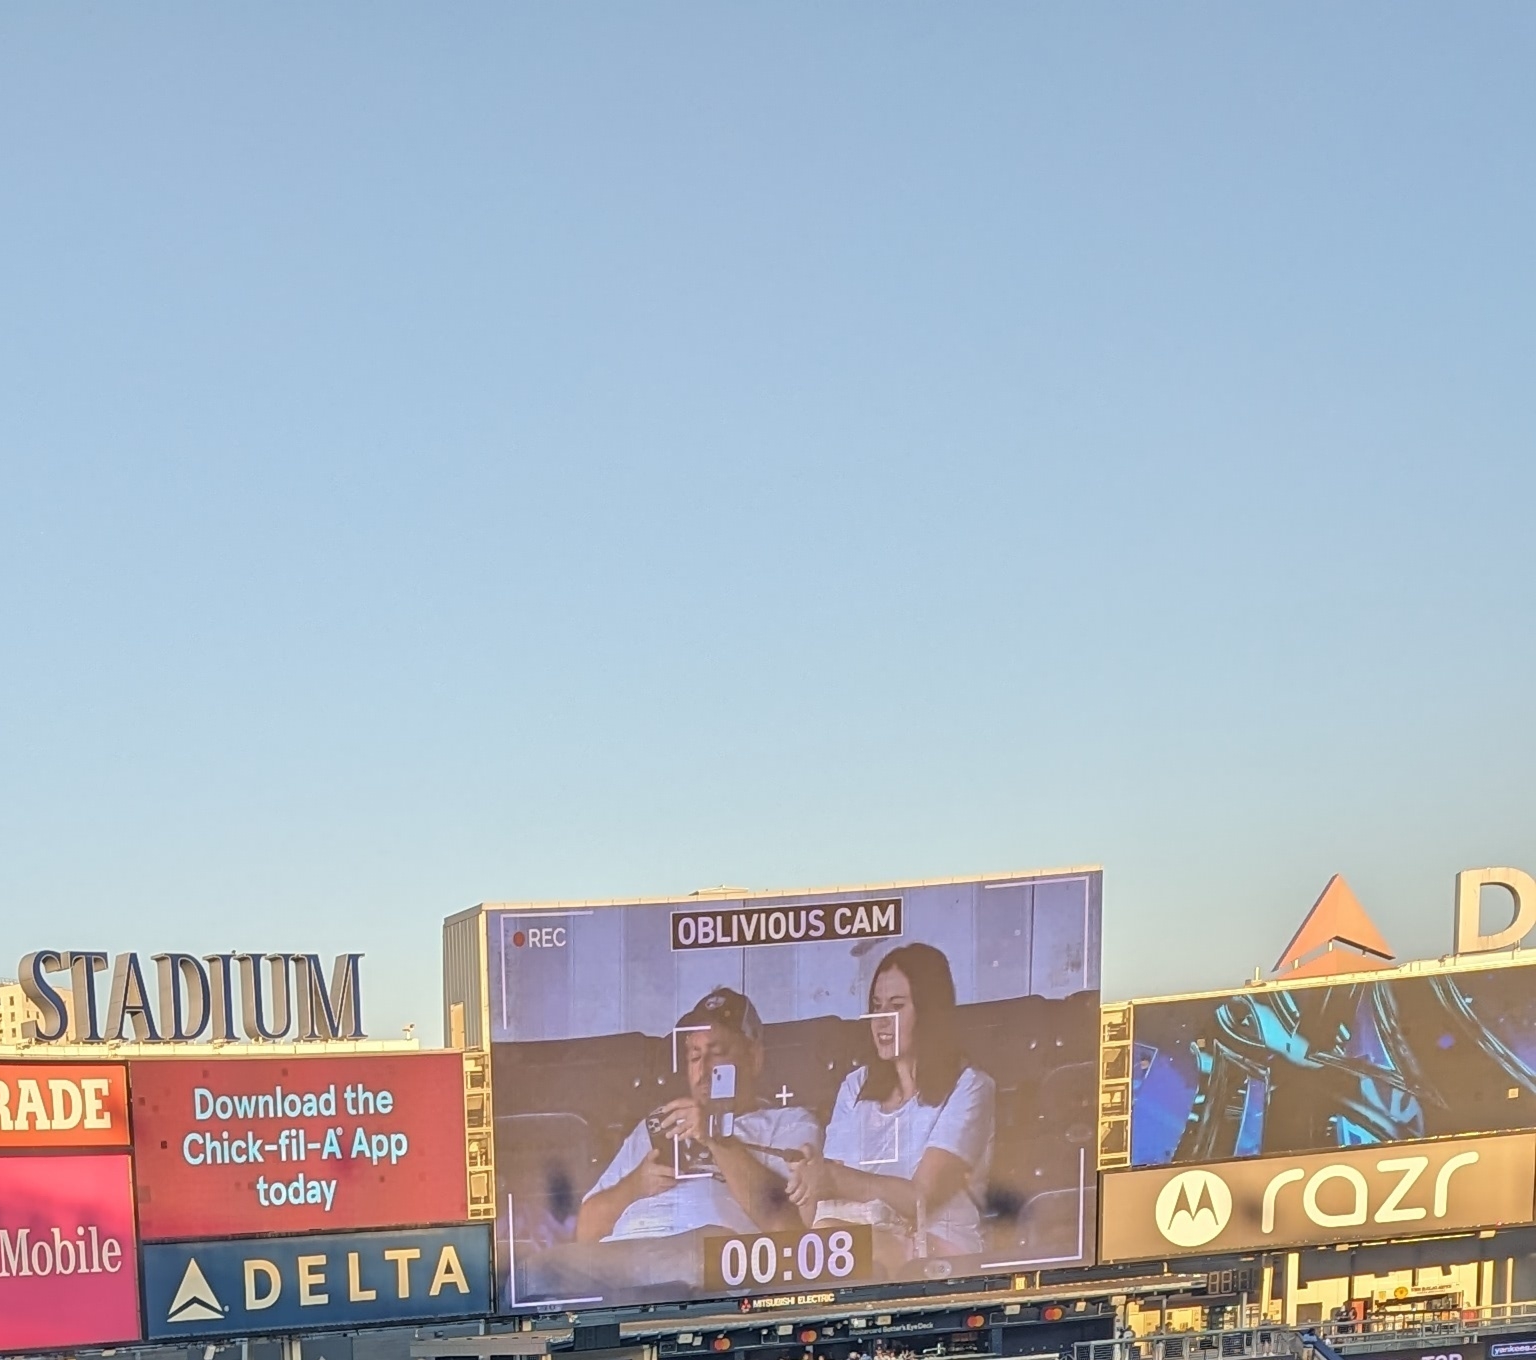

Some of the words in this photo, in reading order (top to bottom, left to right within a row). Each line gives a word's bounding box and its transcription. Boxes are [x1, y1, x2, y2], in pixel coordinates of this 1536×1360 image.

[527, 928, 567, 949] REC
[677, 907, 826, 947] OBLIVIOUS
[833, 903, 897, 936] CAM
[18, 948, 368, 1044] STADIUM
[193, 1084, 336, 1120] Download
[344, 1083, 393, 1117] the
[351, 1129, 408, 1165] App
[257, 1176, 337, 1212] today
[1262, 1151, 1479, 1234] razr
[244, 1245, 470, 1311] DELTA
[721, 1231, 854, 1286] 00:08
[798, 1293, 834, 1304] ELECTRIC
